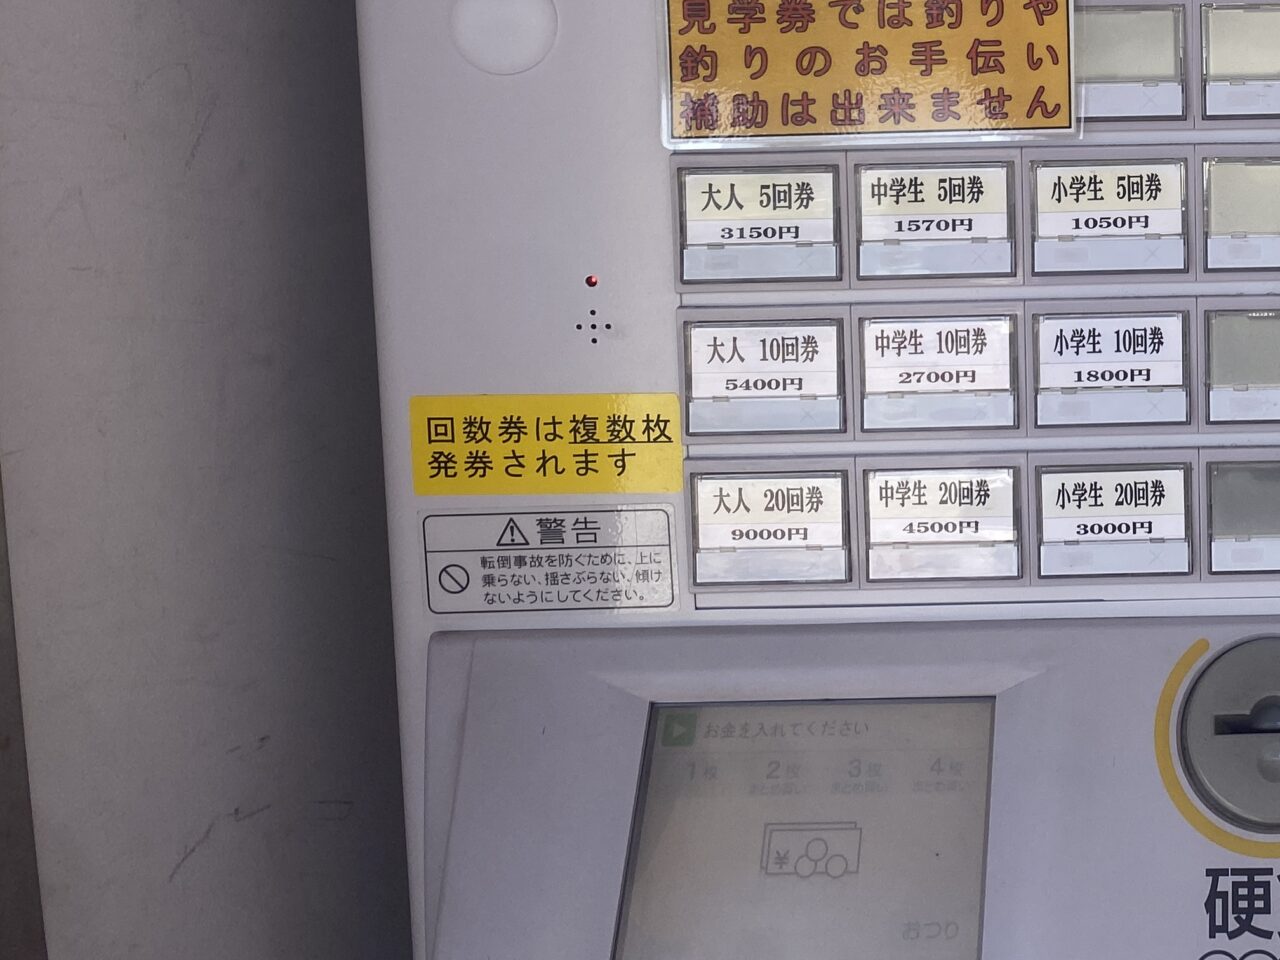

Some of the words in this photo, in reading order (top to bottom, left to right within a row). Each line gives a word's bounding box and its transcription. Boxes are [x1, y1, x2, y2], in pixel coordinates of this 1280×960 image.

[678, 38, 1060, 83] 釣りのお手伝い
[679, 85, 1062, 132] 補助は出来ません
[701, 183, 745, 213] 大人
[759, 180, 816, 211] 5回券
[870, 177, 926, 206] 中学生
[937, 175, 985, 204] 5回券
[1050, 176, 1106, 204] 小学生
[1116, 174, 1163, 203] 5回券
[720, 224, 801, 241] 3150円
[893, 217, 975, 233] 1570円
[1070, 214, 1150, 231] 1050円
[706, 336, 746, 365] 大人
[758, 334, 820, 364] 10回券
[874, 328, 926, 358] 中学生
[935, 326, 988, 356] 10回券
[1053, 327, 1103, 356] 小学生
[1113, 325, 1164, 355] 10回券
[724, 375, 804, 392] 5400円
[898, 368, 977, 385] 2700円
[1072, 367, 1152, 383] 1800円
[426, 413, 674, 444] 回数券は複数枚
[427, 447, 637, 479] 発券されます
[712, 487, 751, 516] 大人
[763, 484, 824, 515] 20回券
[879, 480, 928, 509] 中学生
[939, 478, 991, 507] 20回券
[1055, 481, 1104, 510] 小学生
[1114, 479, 1166, 509] 20回券
[535, 516, 601, 546] 警告
[730, 525, 809, 542] 9000円
[902, 519, 980, 535] 4500円
[1076, 519, 1154, 536] 3000円
[480, 551, 663, 570] 転倒事故を防ぐために、上に
[481, 569, 663, 587] 乗らない、揺さぶらない、傾け
[483, 587, 646, 605] ないようにしてください。
[703, 718, 870, 739] お金を入れてください
